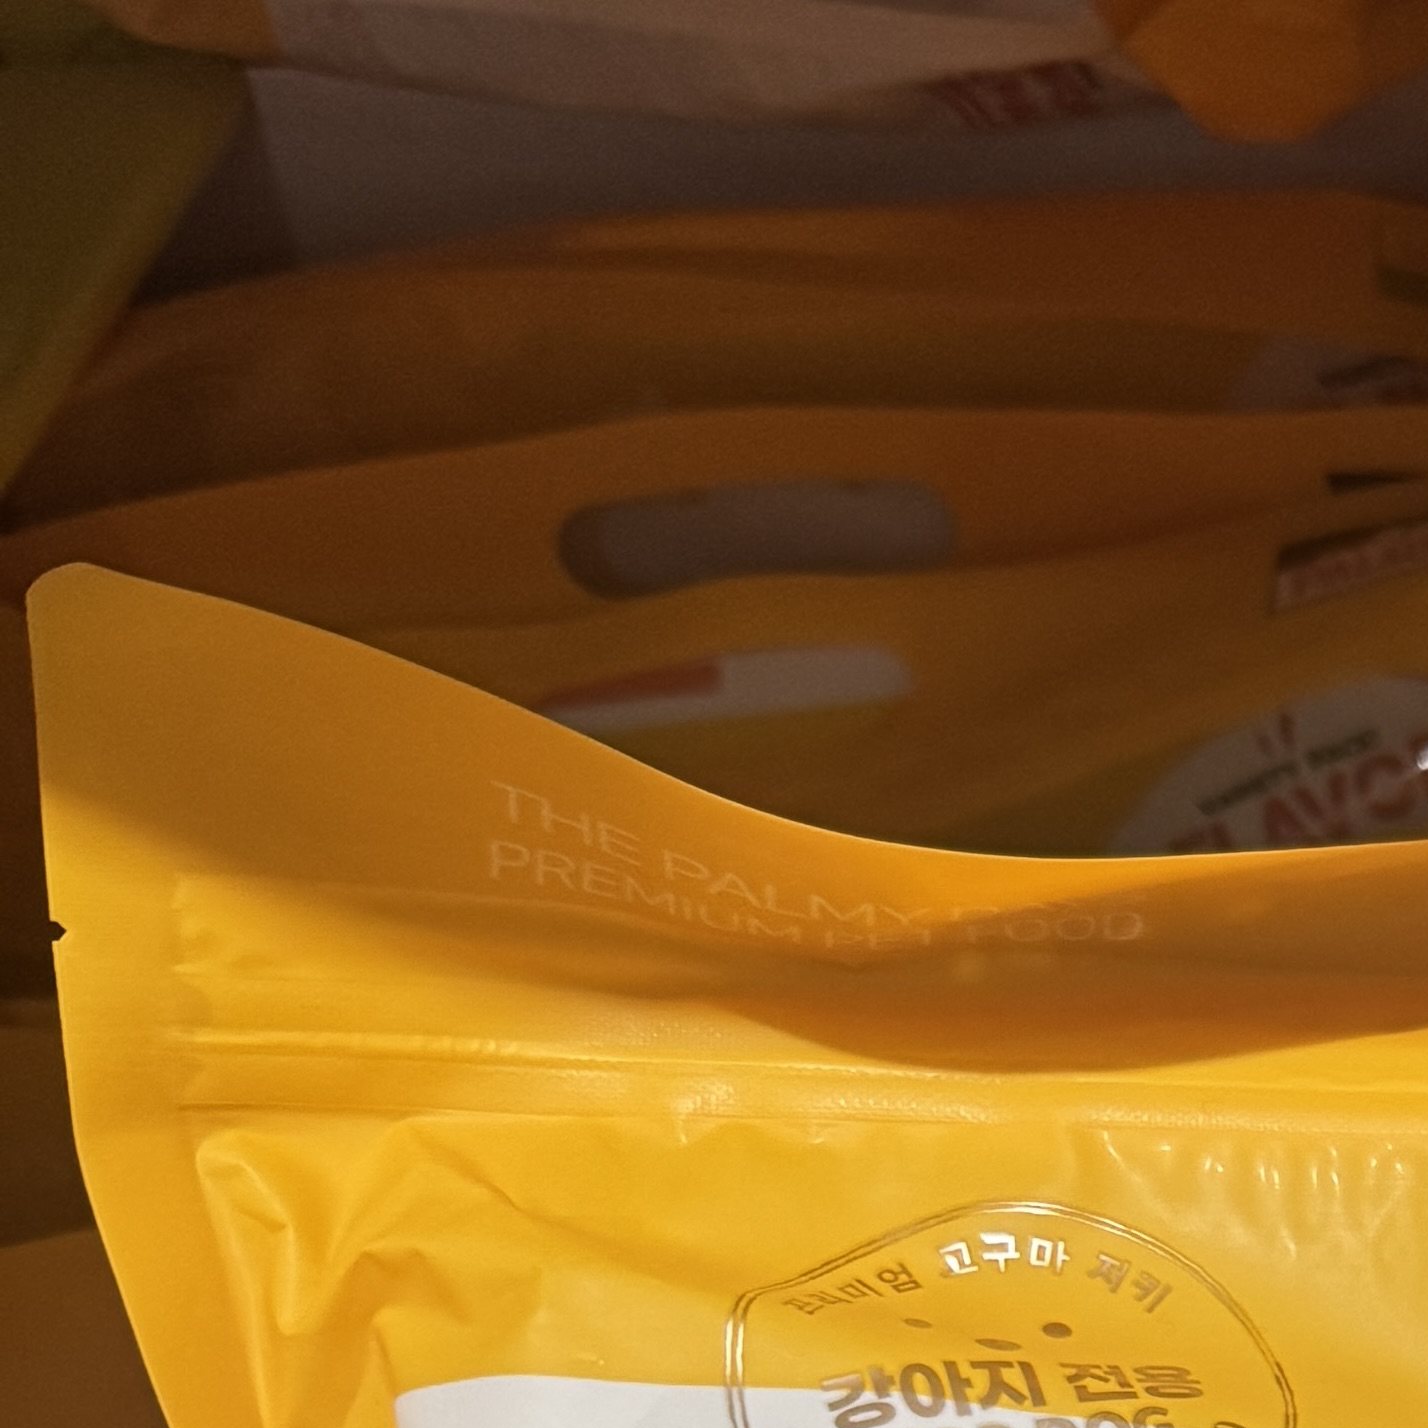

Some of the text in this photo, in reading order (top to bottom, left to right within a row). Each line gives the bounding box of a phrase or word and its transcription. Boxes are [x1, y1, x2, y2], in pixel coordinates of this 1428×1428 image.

[489, 780, 642, 870] THE
[487, 840, 802, 945] PREMIUM
[937, 1231, 1071, 1278] 고구마
[1086, 1251, 1173, 1314] 저키
[1062, 1362, 1205, 1401] 전용
